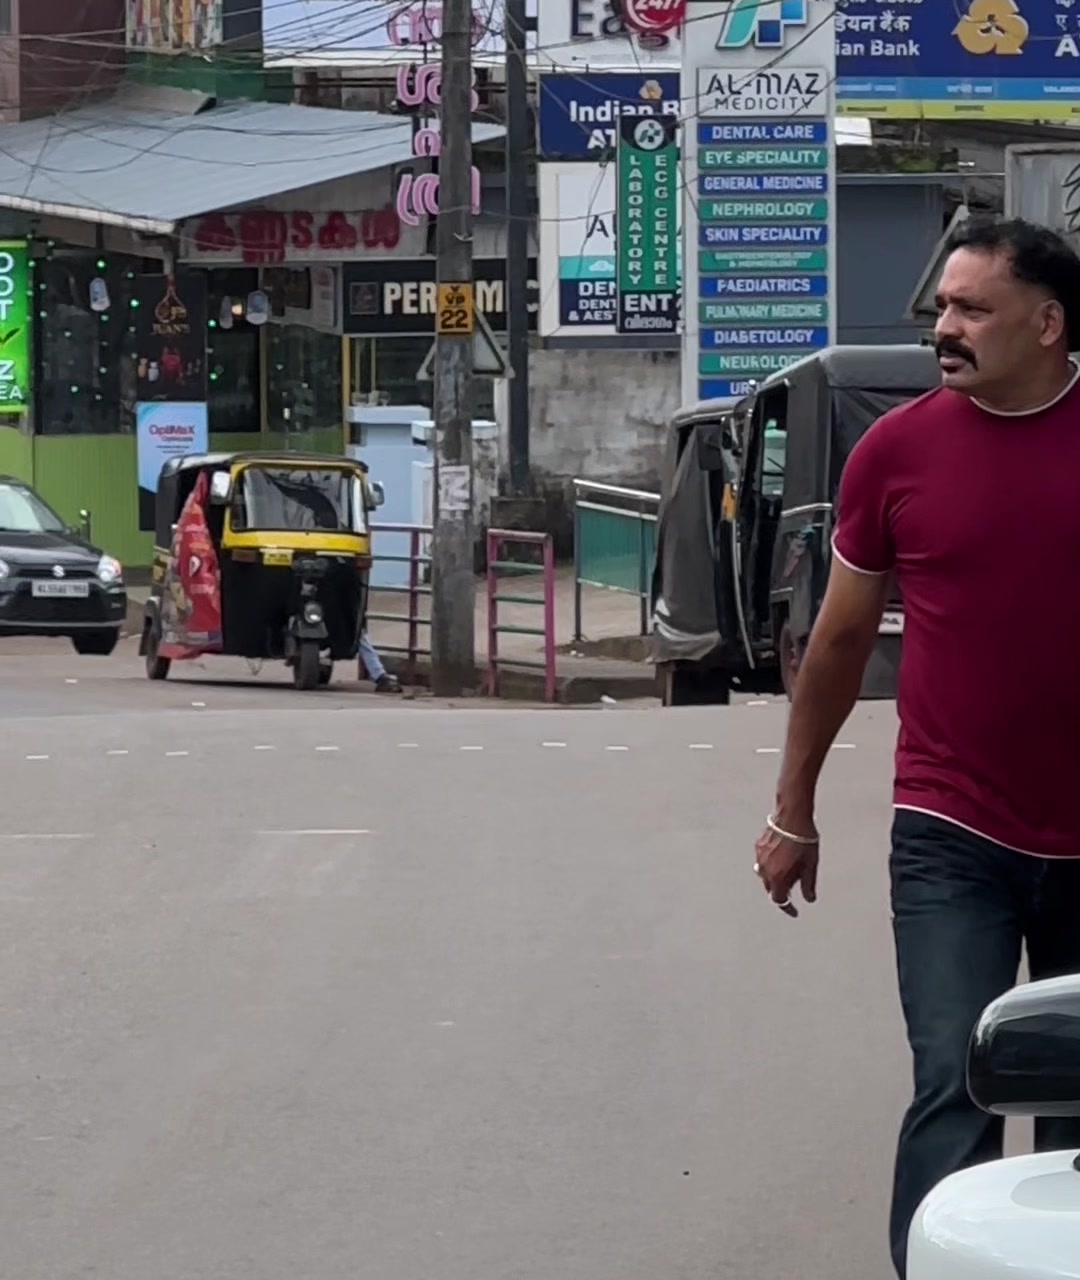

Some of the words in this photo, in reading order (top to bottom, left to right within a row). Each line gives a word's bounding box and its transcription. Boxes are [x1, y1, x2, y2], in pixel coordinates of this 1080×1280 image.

[835, 40, 865, 56] ian
[870, 39, 920, 56] Bank
[705, 73, 820, 95] AL-MAZ
[714, 97, 813, 110] MEDICITY
[712, 125, 770, 140] DENTAL
[773, 125, 814, 139] CARE
[705, 151, 732, 164] EYE
[736, 150, 821, 164] SPECIALITY
[654, 155, 669, 199] ECG
[704, 176, 761, 190] GENERAL
[762, 176, 823, 190] MEDICINE
[712, 203, 814, 216] NEPHROLOGY
[628, 155, 643, 285] LABORATORY
[705, 228, 739, 242] SKIN
[742, 227, 822, 241] SPECIALITY
[654, 208, 669, 285] CENTRE
[717, 278, 811, 293] PAEDIATRICS
[624, 294, 674, 312] ENT
[440, 309, 469, 329] 22
[714, 329, 814, 344] DIABETOLOGY
[719, 355, 803, 369] NEUROLOG
